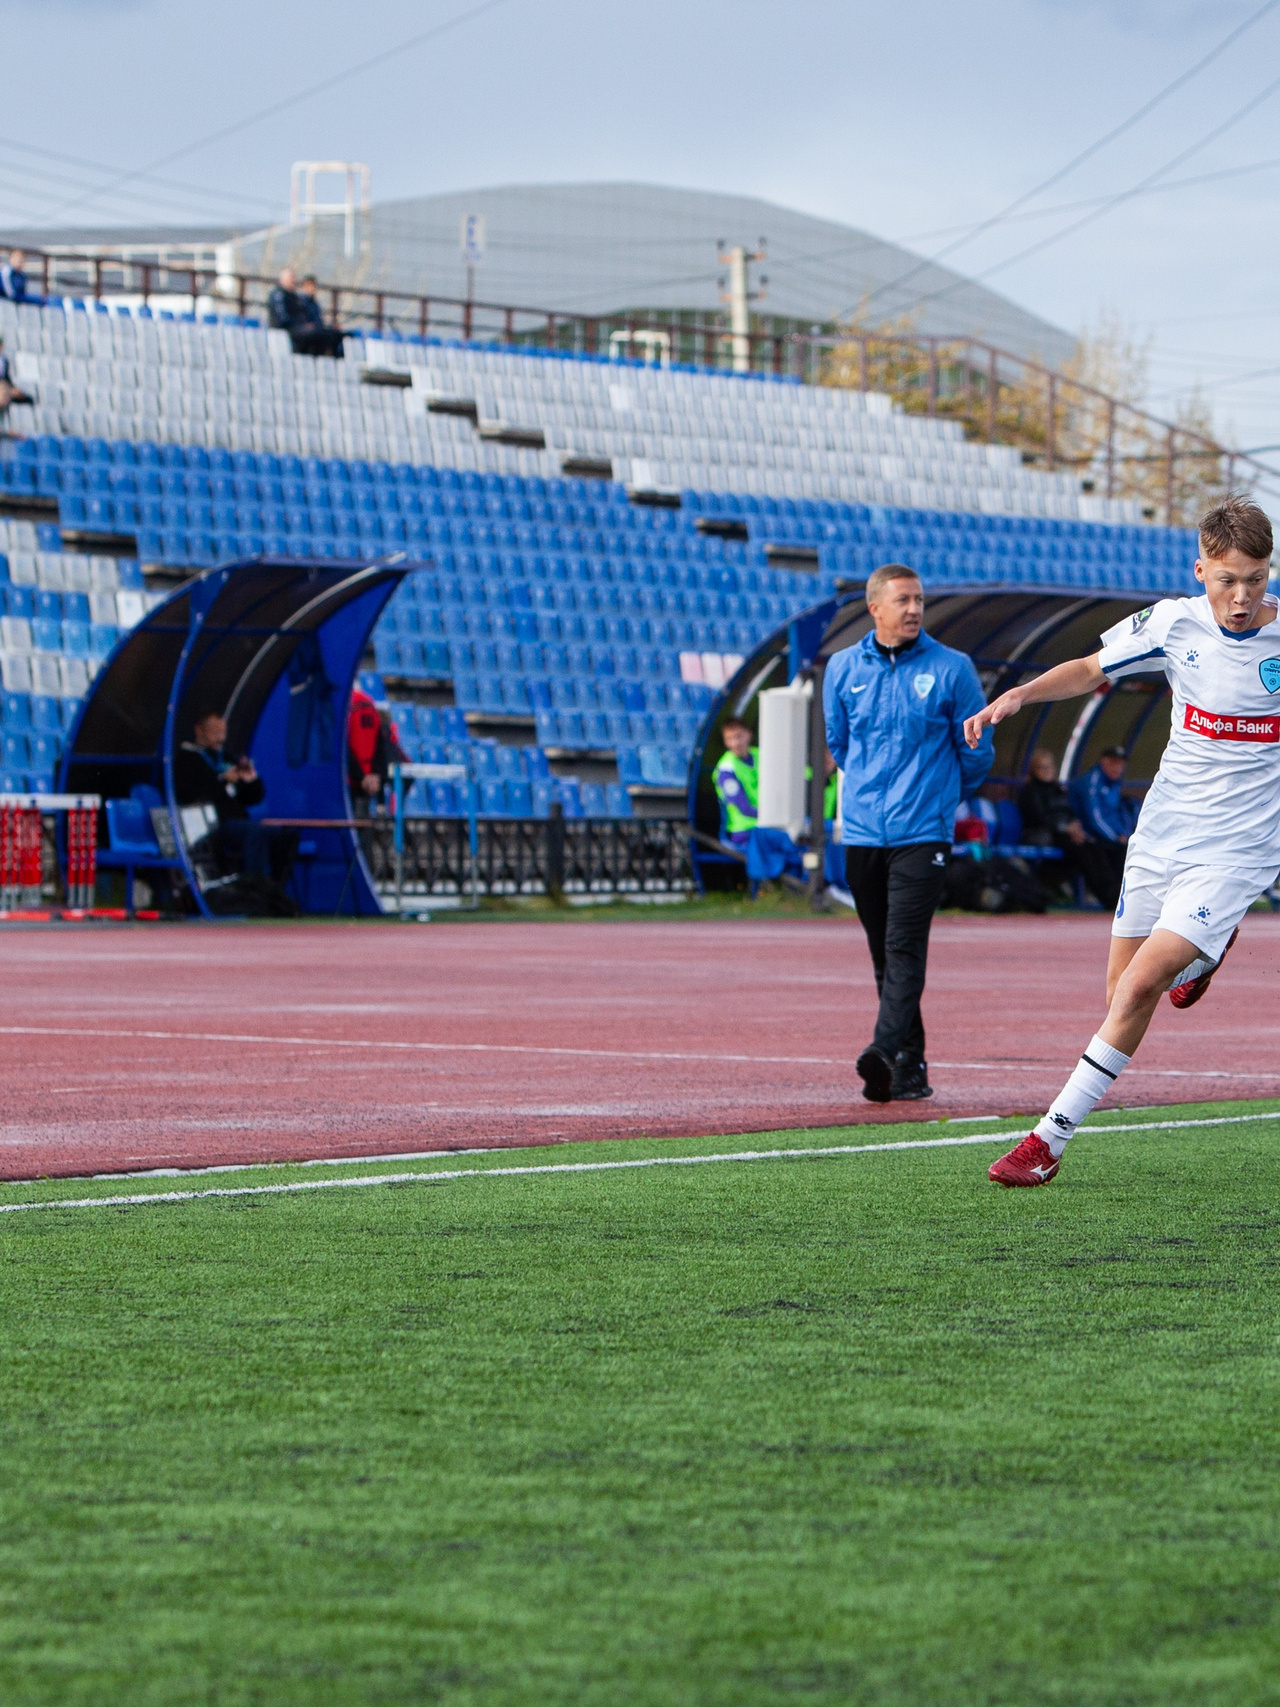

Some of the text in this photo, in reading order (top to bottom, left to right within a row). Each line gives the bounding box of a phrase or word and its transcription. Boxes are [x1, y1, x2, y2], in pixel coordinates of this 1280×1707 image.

[1190, 710, 1274, 734] Альфа Банк
[1189, 914, 1209, 927] KELME
